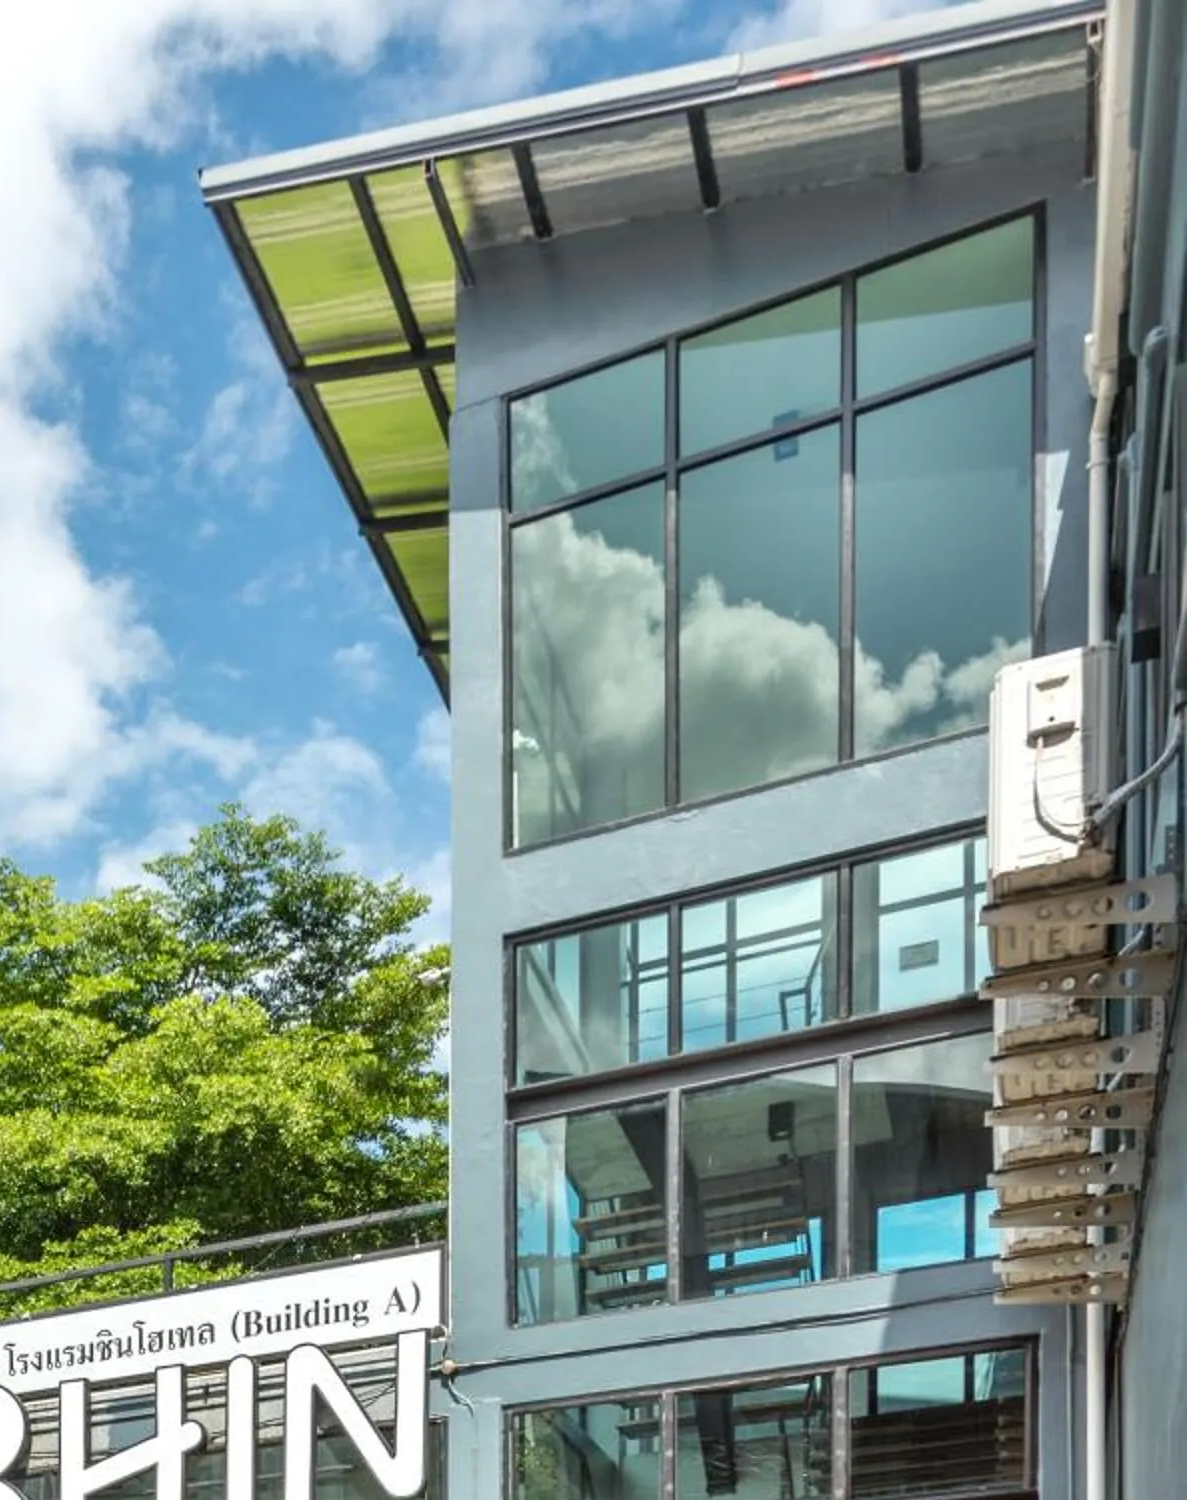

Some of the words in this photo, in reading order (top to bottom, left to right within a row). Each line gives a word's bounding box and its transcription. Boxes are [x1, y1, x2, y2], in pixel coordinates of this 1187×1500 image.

[231, 1296, 370, 1344] (Building
[384, 1280, 422, 1315] A)
[3, 1320, 215, 1377] โรงแรมชินโฮเทล
